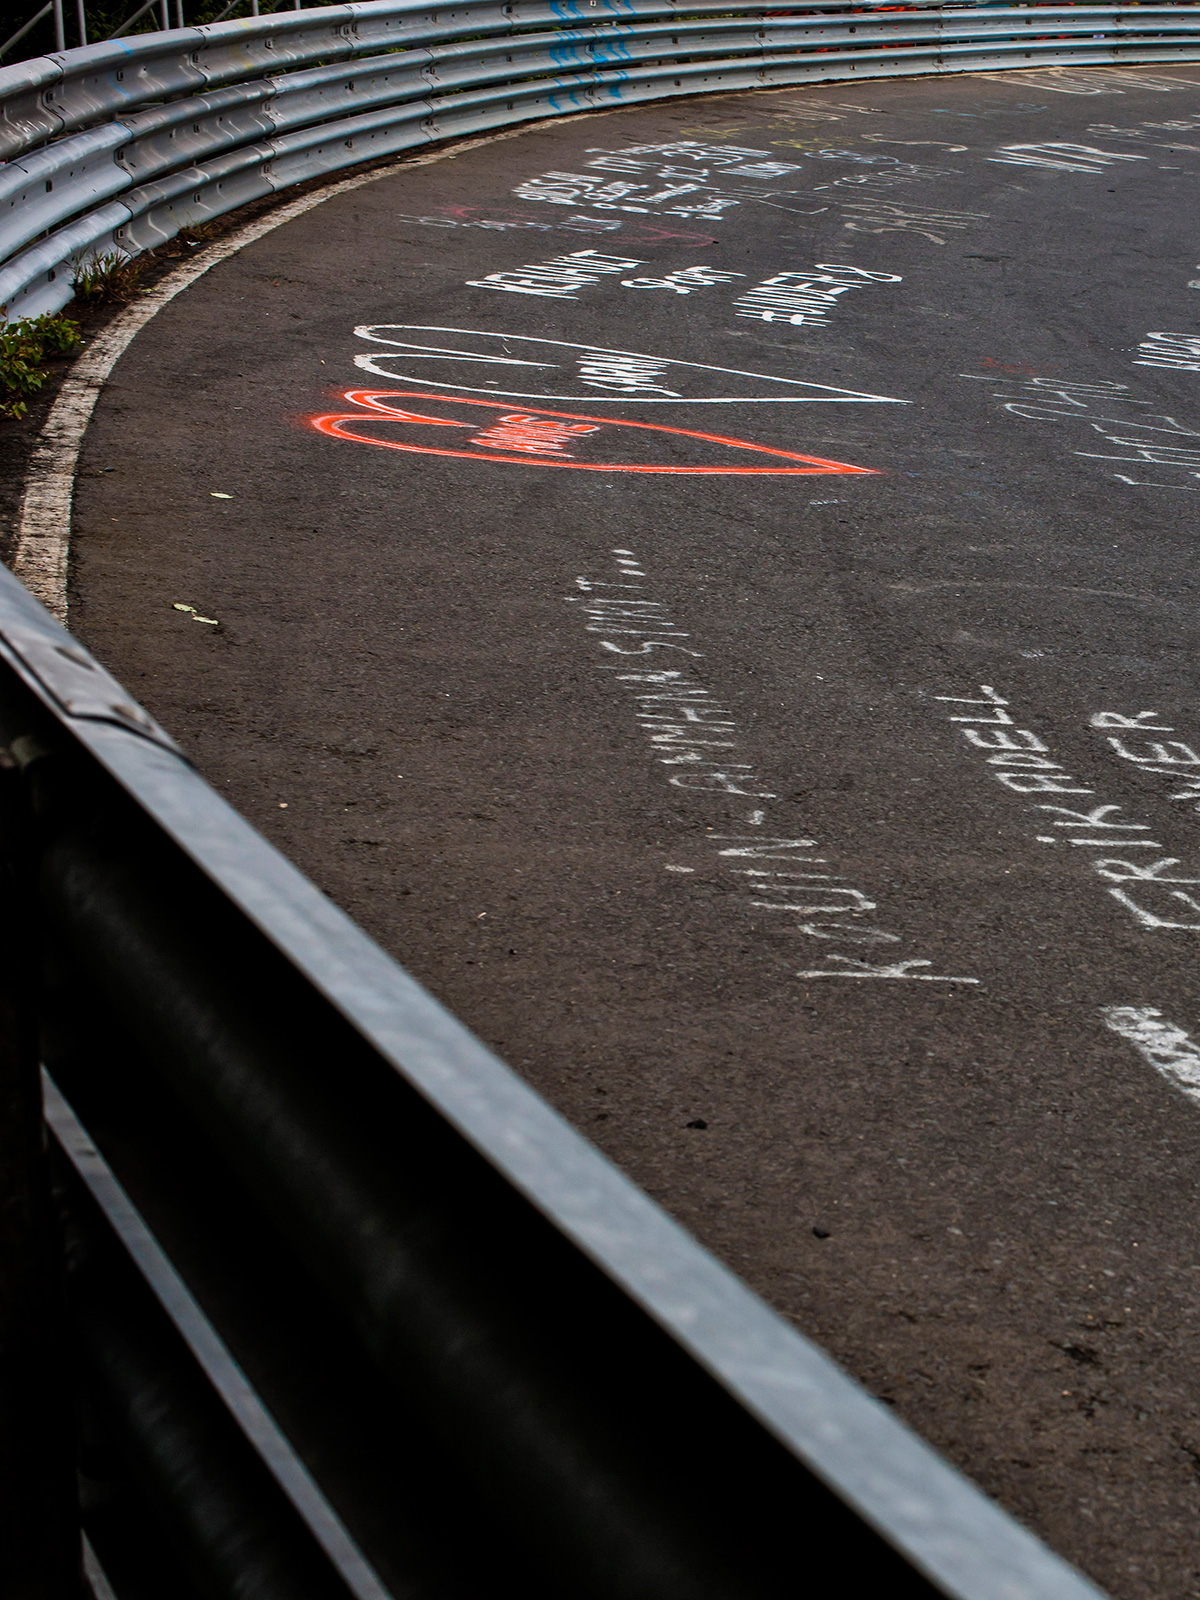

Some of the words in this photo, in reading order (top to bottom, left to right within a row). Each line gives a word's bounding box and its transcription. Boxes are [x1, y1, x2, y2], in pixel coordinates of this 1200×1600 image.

[465, 249, 650, 301] RENAULT
[620, 265, 747, 296] SPORT
[576, 352, 683, 398] SARAH
[934, 684, 1095, 794] ADELL
